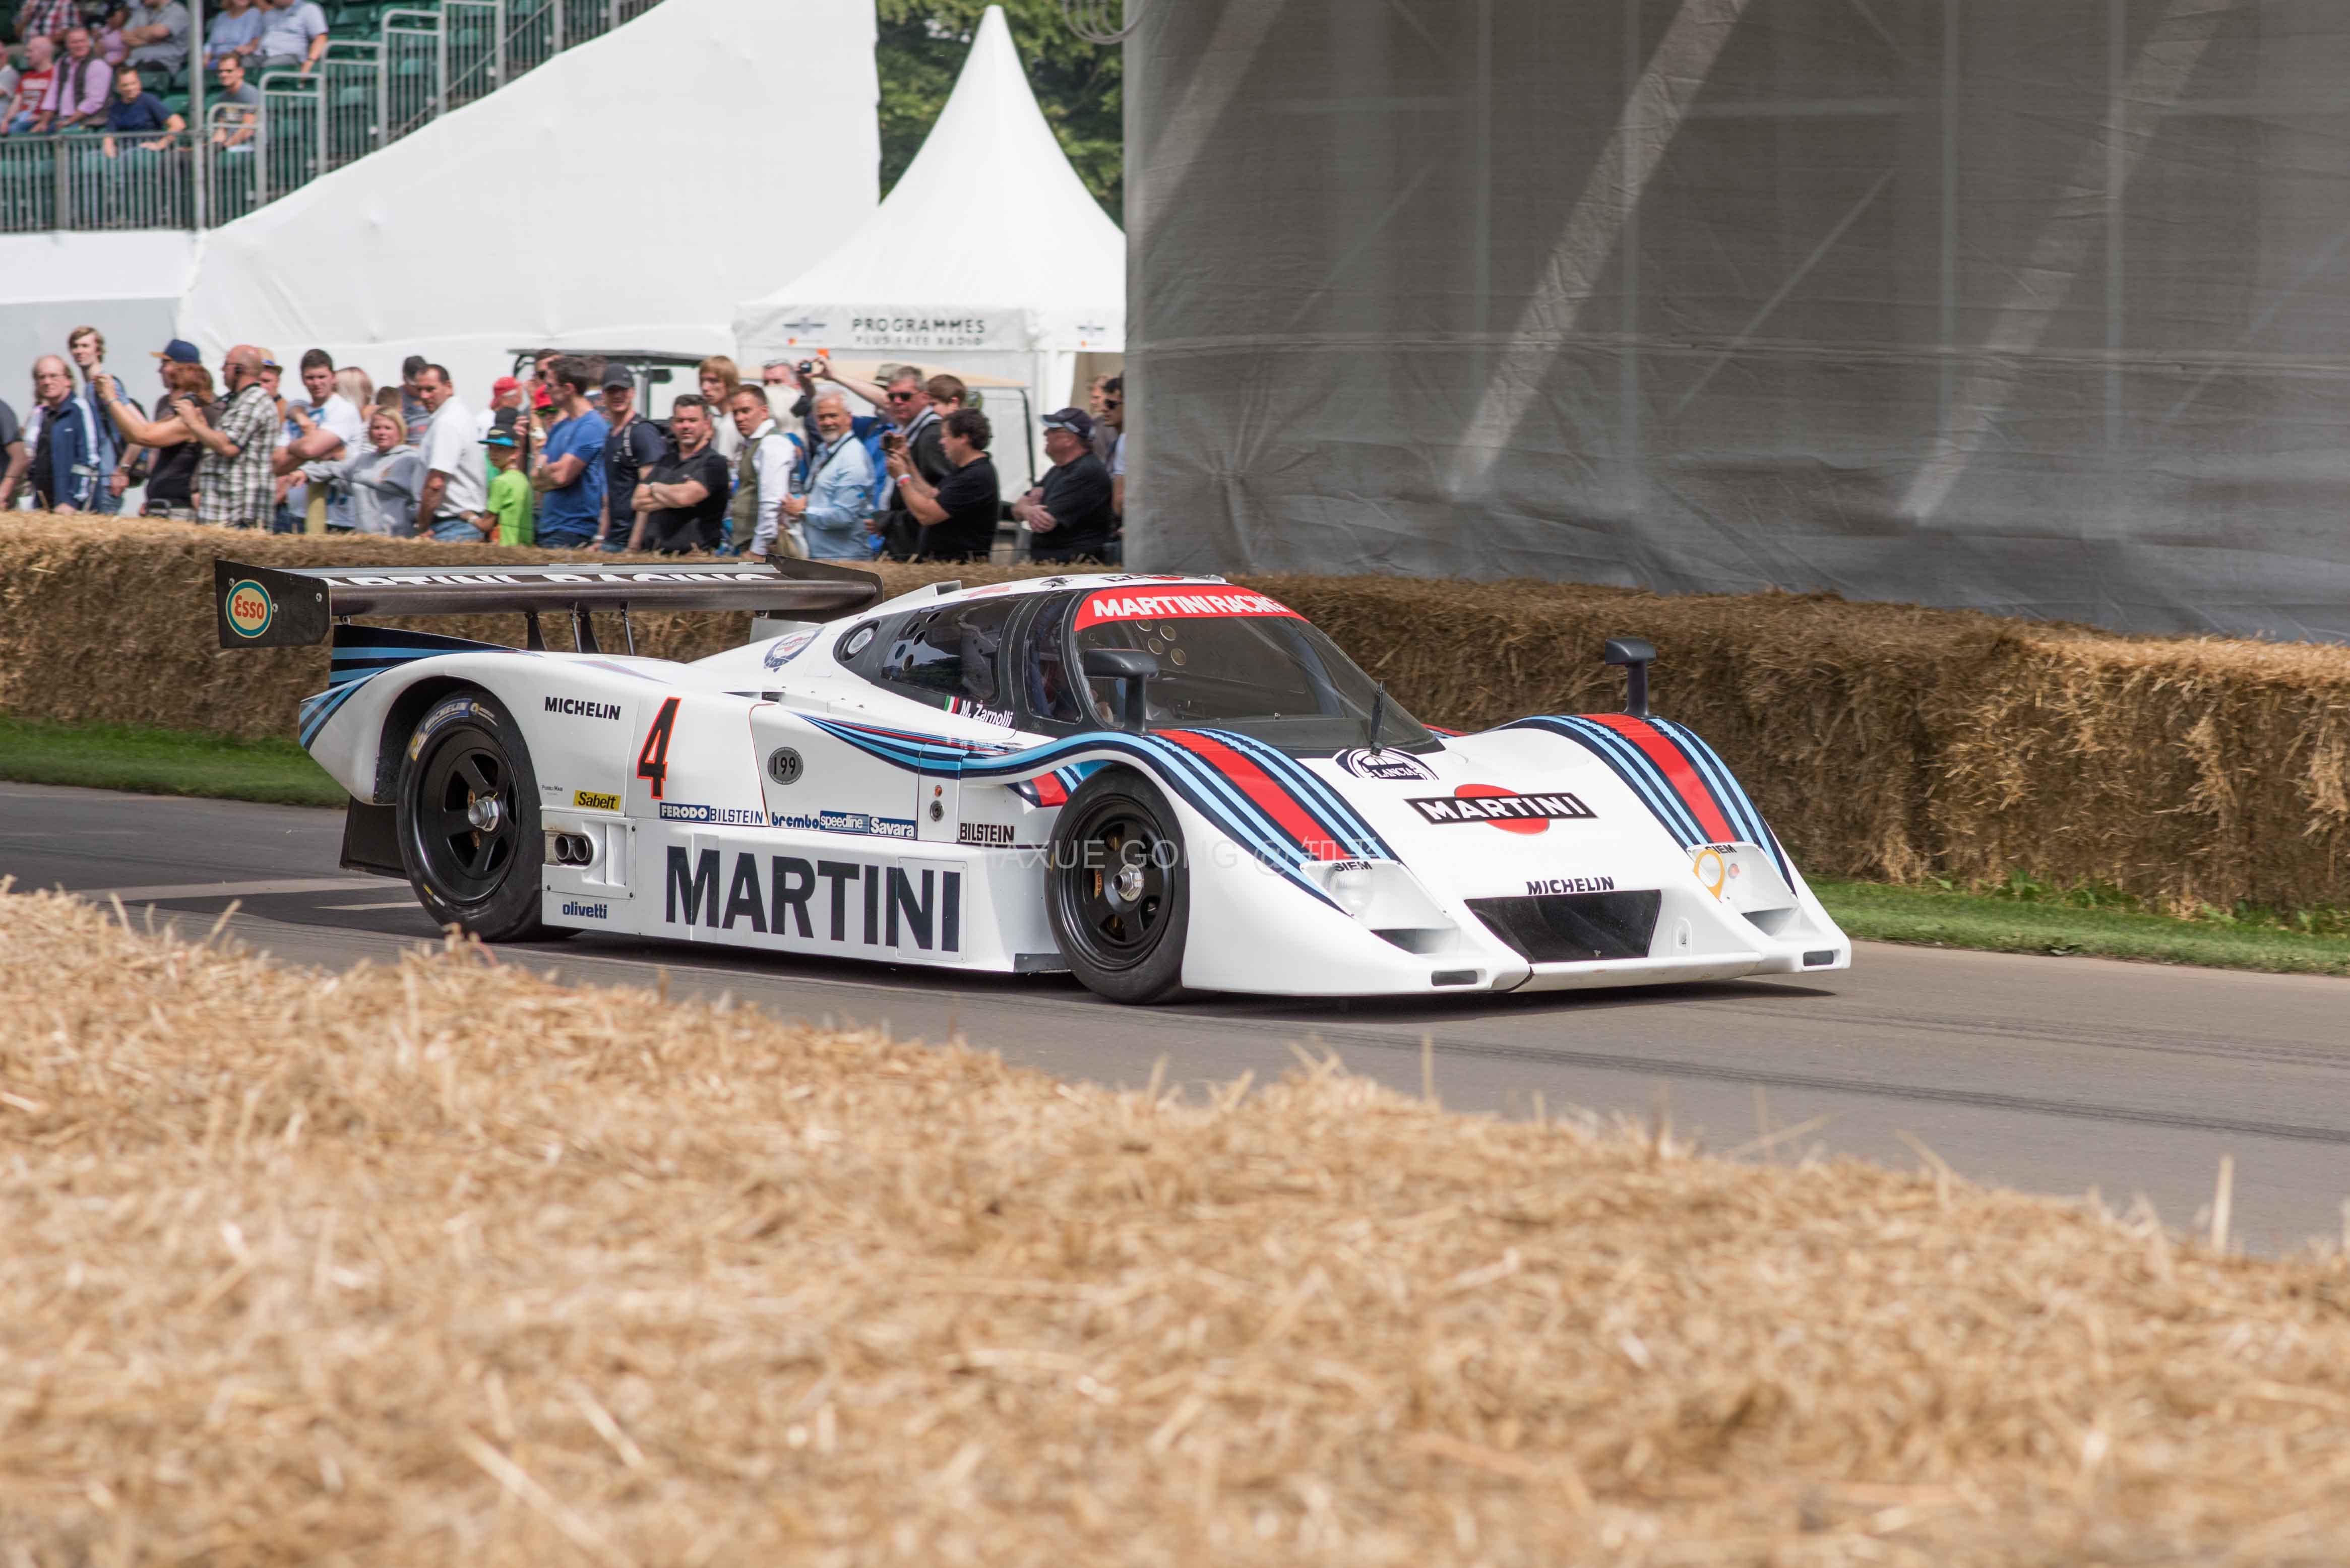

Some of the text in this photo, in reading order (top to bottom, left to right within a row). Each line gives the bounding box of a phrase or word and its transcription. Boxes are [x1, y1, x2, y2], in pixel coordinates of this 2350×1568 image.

[852, 318, 985, 334] PROGRAMMES
[1093, 595, 1291, 617] MARTINI RACING
[544, 696, 621, 720] MICHELIN
[637, 697, 682, 800] 4
[774, 757, 796, 776] 199
[1371, 767, 1419, 778] LANCIA
[578, 792, 616, 809] Sabelt
[1417, 796, 1587, 821] MARTINI
[661, 805, 914, 837] FERODO BILSTEIN brembo speedline Savara
[960, 823, 1014, 843] BILSTEIN
[1333, 861, 1372, 871] SIEM
[1526, 876, 1614, 895] MICHELIN
[665, 846, 960, 952] MARTINI
[563, 901, 607, 919] olivetti
